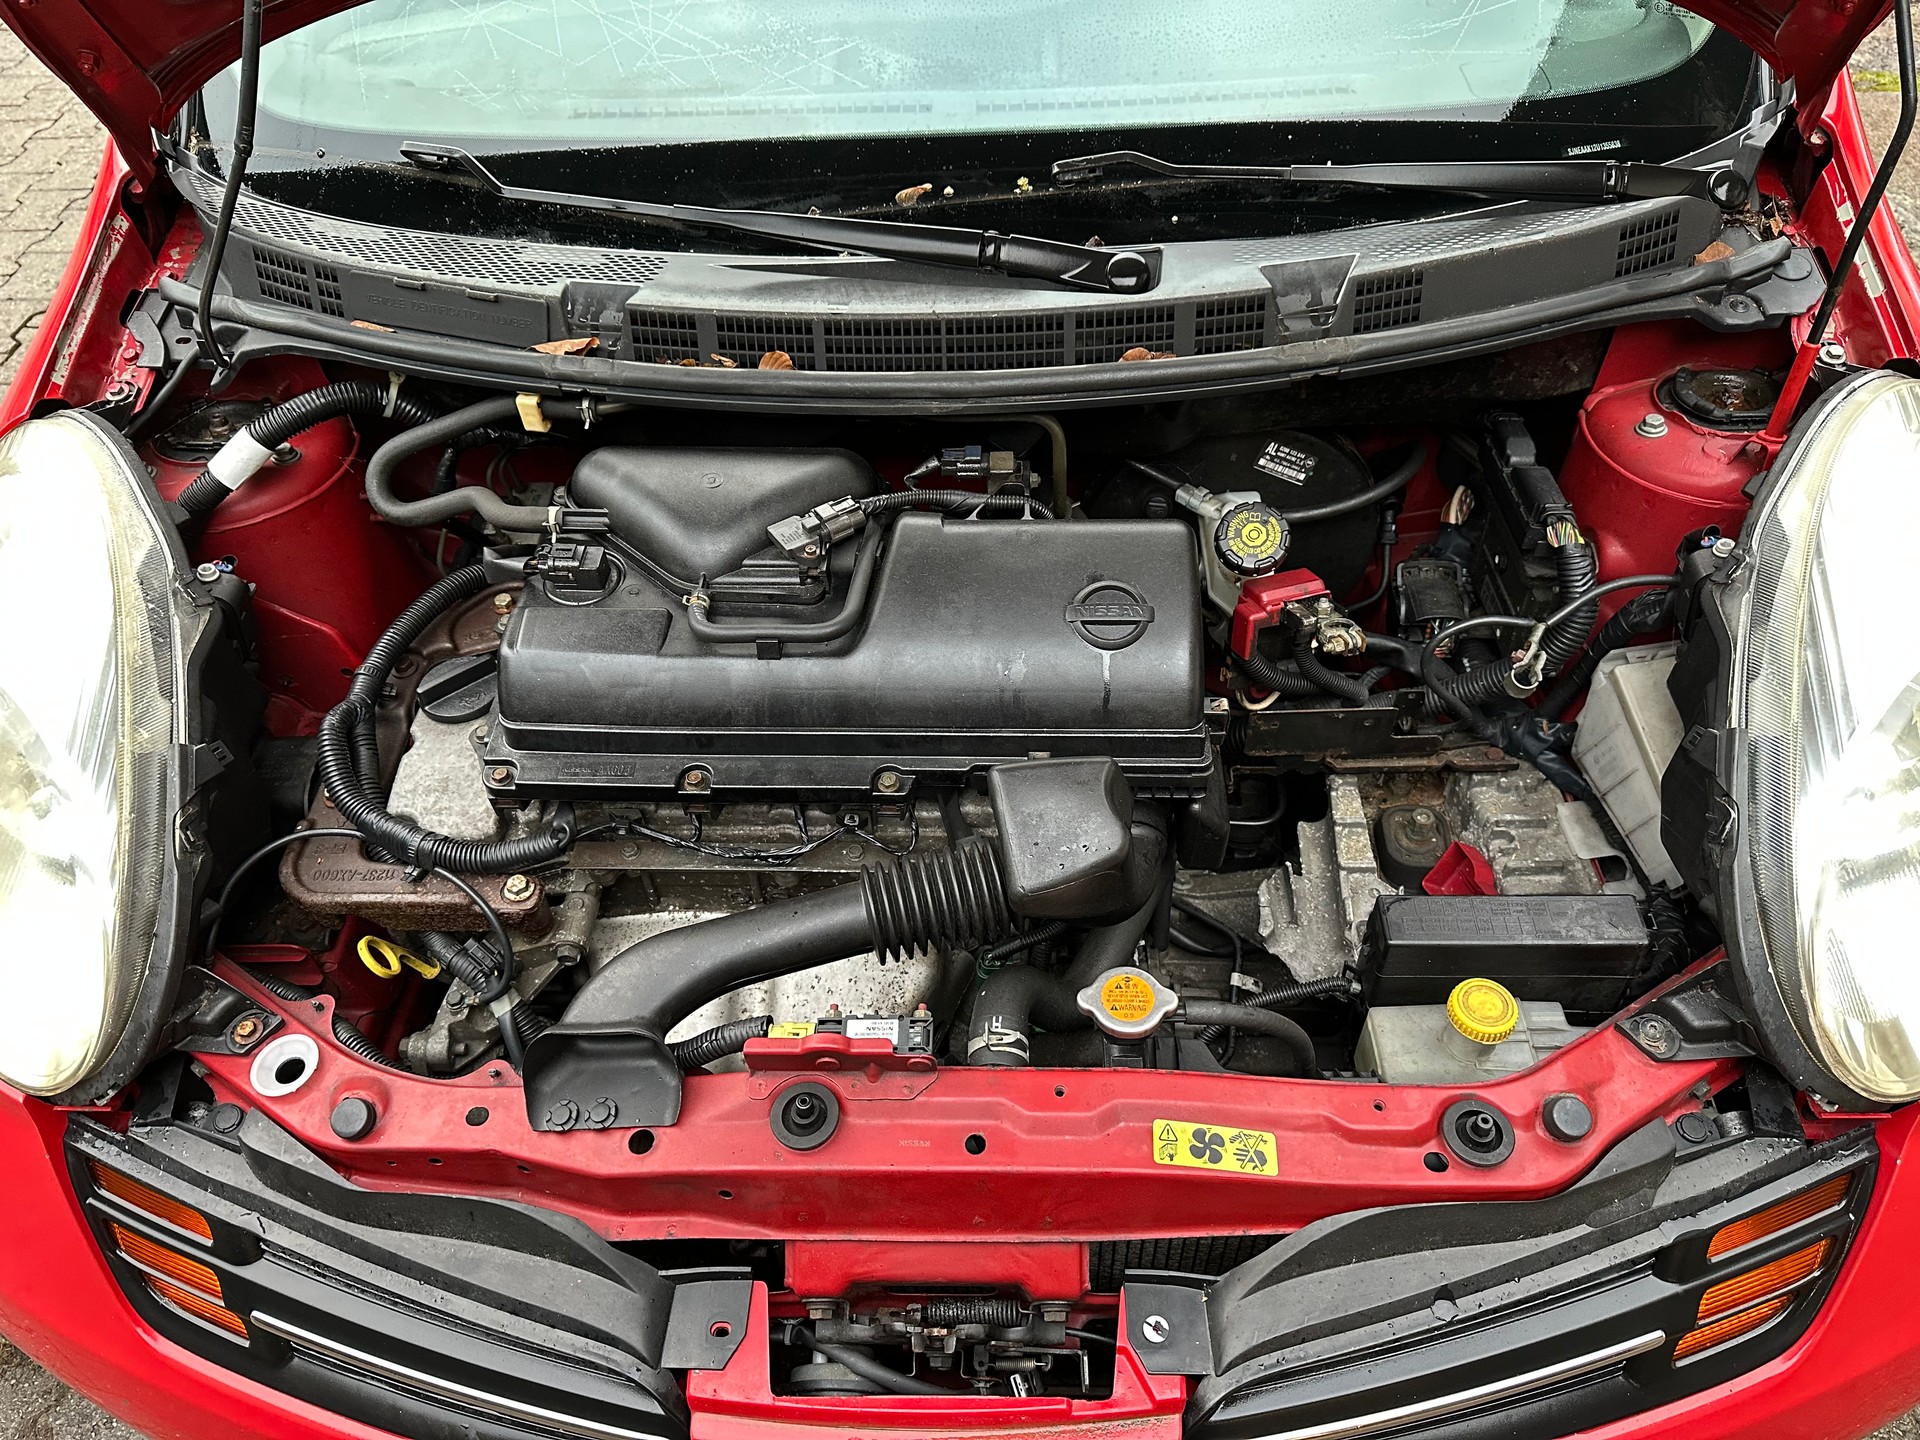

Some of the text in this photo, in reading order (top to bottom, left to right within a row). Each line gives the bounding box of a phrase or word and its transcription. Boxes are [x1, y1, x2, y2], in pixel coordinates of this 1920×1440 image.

[1265, 442, 1278, 456] AL
[1227, 511, 1249, 538] WARNING
[1075, 605, 1148, 618] NISSAN
[1119, 1003, 1147, 1012] WARNING
